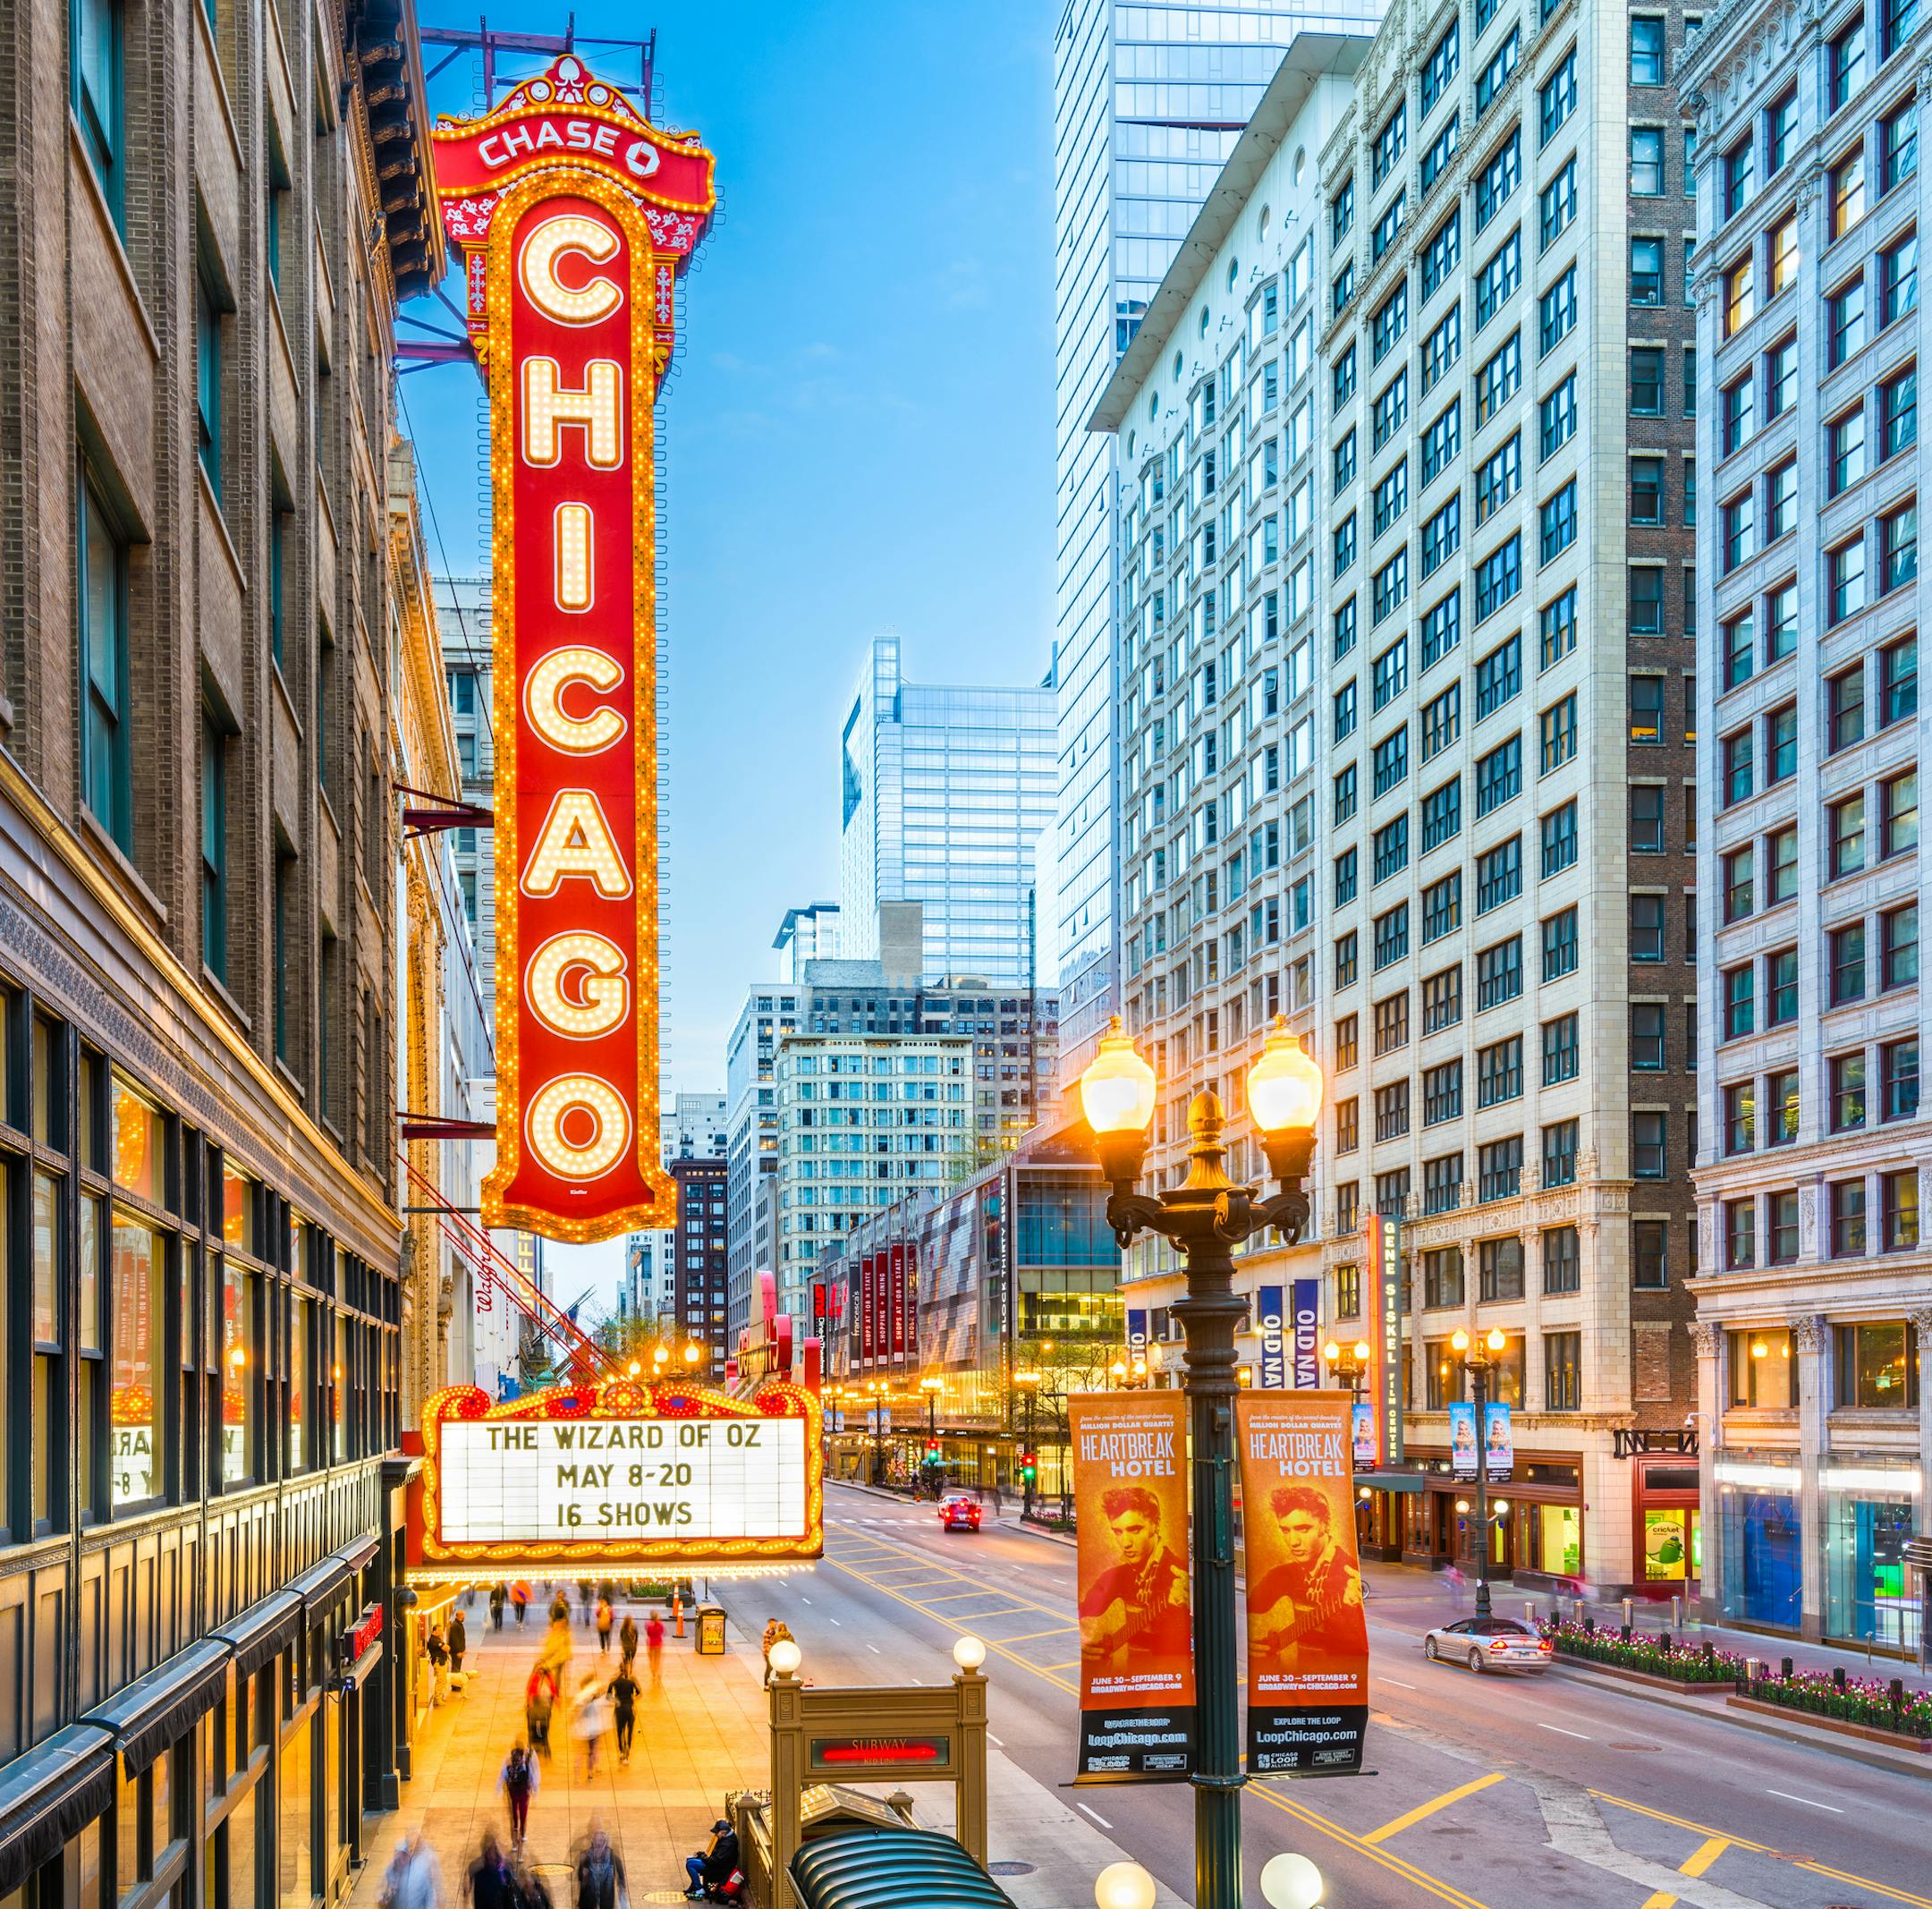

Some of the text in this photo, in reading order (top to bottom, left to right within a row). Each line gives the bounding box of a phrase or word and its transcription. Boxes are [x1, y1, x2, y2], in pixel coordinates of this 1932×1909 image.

[478, 121, 621, 169] CHASE
[518, 214, 634, 1183] CHICAGO
[894, 1258, 902, 1279] STATE
[851, 1290, 860, 1337] francesca's
[864, 1314, 871, 1324] AT
[895, 1305, 903, 1315] AT
[895, 1317, 903, 1340] SHOPS
[1296, 1310, 1316, 1351] OLD
[1384, 1222, 1397, 1458] GENE SISKEL FILM CENTER
[1263, 1314, 1282, 1388] OLD NA
[487, 1424, 762, 1450] THE WIZARD OF OZ
[1080, 1431, 1175, 1461] HEARTBREAK
[1250, 1433, 1345, 1460] HEARTBREAK
[557, 1463, 692, 1488] MAY 8-20
[1111, 1459, 1175, 1478] HOTEL
[1279, 1460, 1346, 1477] HOTEL
[558, 1502, 692, 1527] 16 SHOWS
[1091, 1677, 1112, 1685] JUNE
[1175, 1674, 1182, 1682] 9
[1258, 1675, 1281, 1683] JUNE
[1351, 1674, 1358, 1682] 9
[1273, 1717, 1342, 1727] EXPLORE THE LOOP
[852, 1738, 907, 1752] SUBWAY
[1088, 1731, 1188, 1748] LoopChicago.com
[1256, 1730, 1358, 1744] LoopChicago.com
